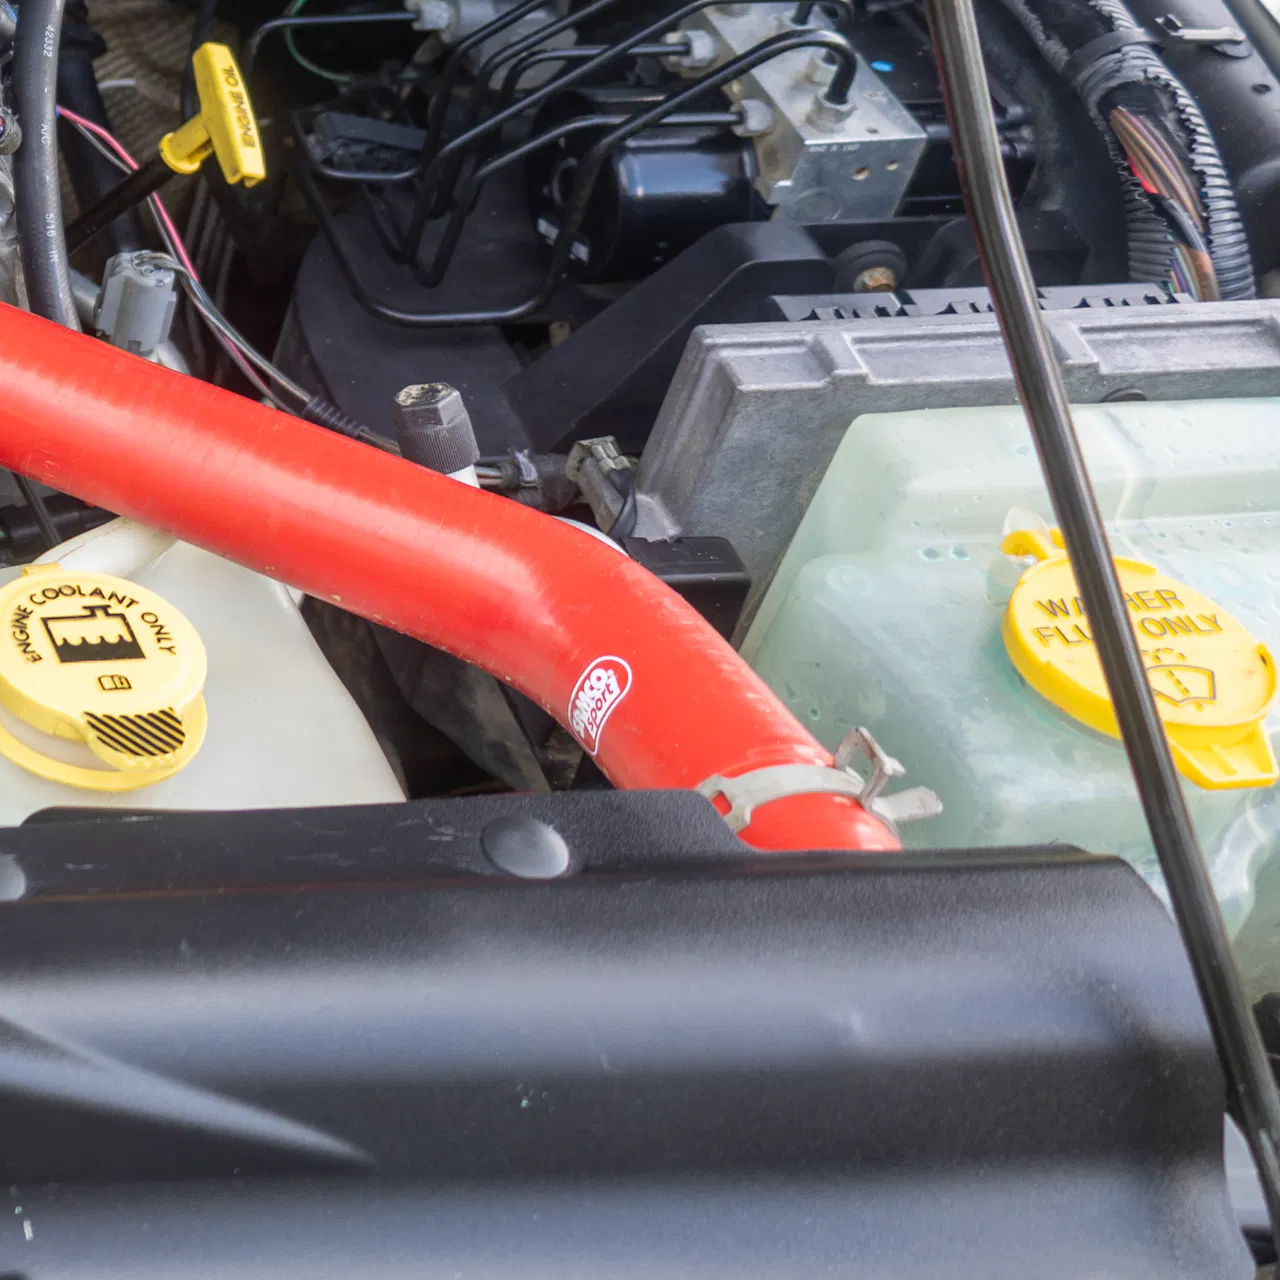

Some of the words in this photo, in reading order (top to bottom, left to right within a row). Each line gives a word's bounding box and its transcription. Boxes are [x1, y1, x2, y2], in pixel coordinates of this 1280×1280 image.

[43, 24, 56, 58] 42332
[221, 64, 239, 88] OIL
[228, 91, 256, 149] ENGINE
[45, 212, 57, 237] 5/16
[11, 604, 43, 664] ENGINE
[29, 584, 140, 608] COOLANT
[140, 611, 178, 655] ONLY
[1139, 612, 1223, 641] ONLY
[587, 682, 615, 731] sport
